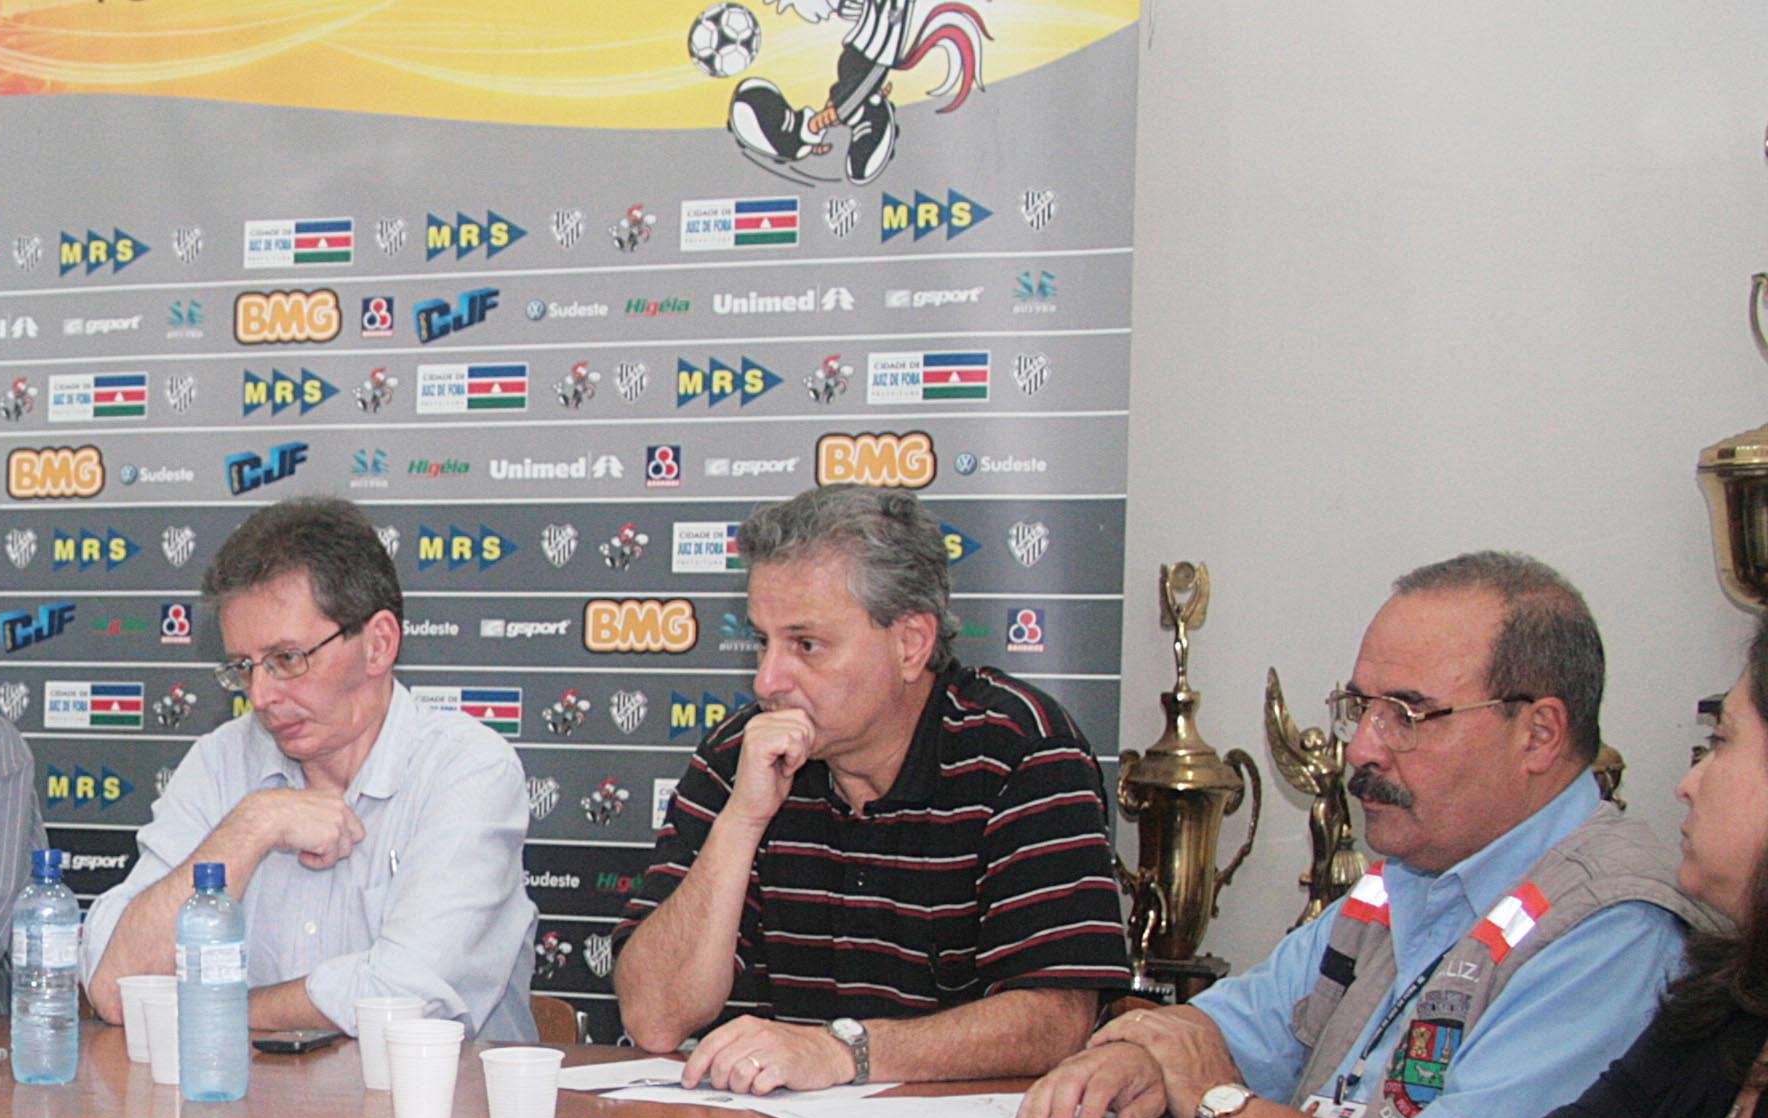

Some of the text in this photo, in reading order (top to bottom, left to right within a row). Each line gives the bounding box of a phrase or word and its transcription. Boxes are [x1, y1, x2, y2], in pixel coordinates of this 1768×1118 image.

[883, 202, 972, 230] MRS
[428, 223, 508, 248] MRS
[62, 238, 133, 263] MRS
[713, 290, 814, 315] Unimed
[913, 287, 984, 308] gsport
[238, 291, 339, 342] BMG
[549, 301, 608, 319] Sudeste
[245, 379, 322, 405] MRS
[678, 368, 764, 394] MRS
[10, 449, 102, 496] BMG
[490, 456, 586, 480] Unimed
[732, 456, 800, 477] gsport
[819, 436, 935, 487] BMG
[981, 455, 1046, 472] Sudeste
[141, 467, 194, 483] Sudeste
[54, 538, 126, 561] MRS
[420, 536, 502, 560] MRS
[506, 619, 571, 638] gsport
[587, 602, 696, 651] BMG
[671, 703, 732, 727] MR
[48, 776, 120, 799] MRS
[72, 854, 129, 870] gsport
[523, 870, 580, 887] Sudeste
